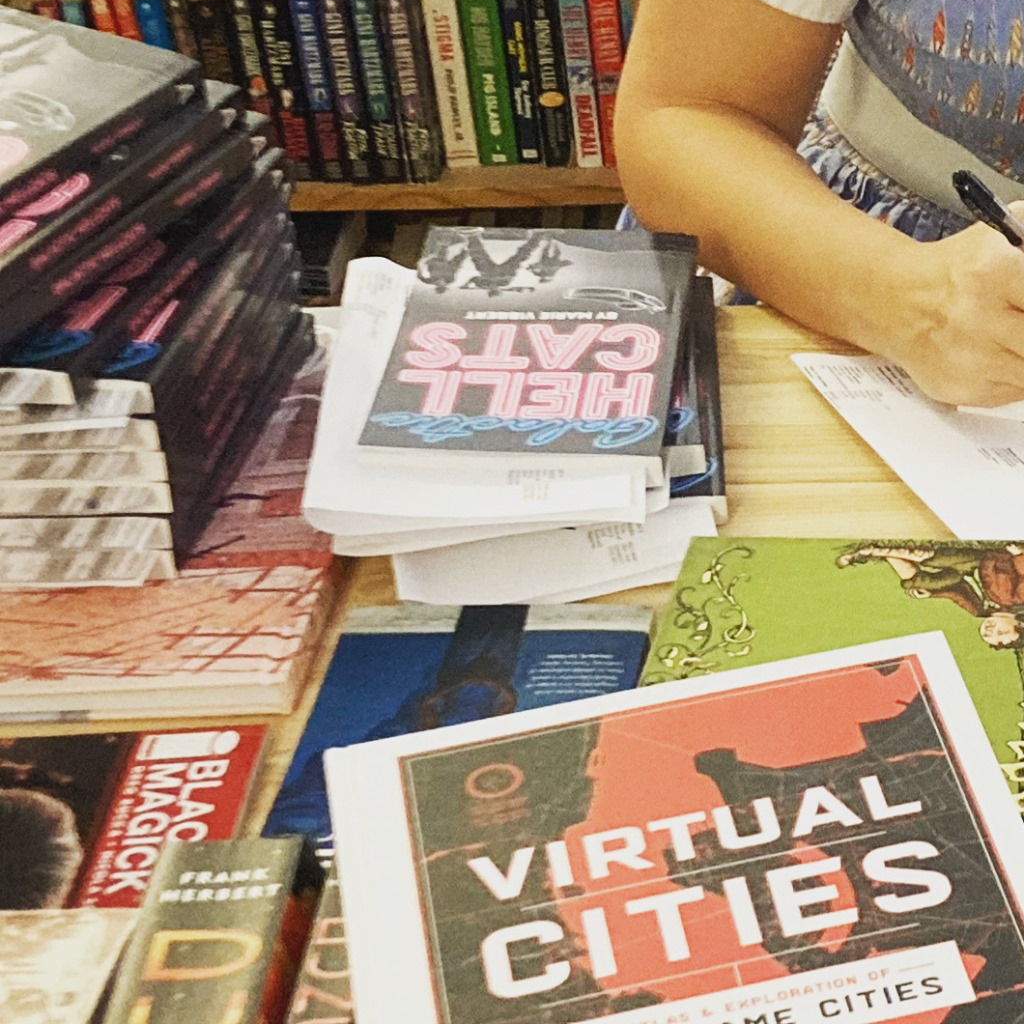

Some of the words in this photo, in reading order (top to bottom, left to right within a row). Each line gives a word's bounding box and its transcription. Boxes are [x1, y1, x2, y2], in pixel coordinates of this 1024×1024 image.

[325, 11, 344, 34] GINI
[355, 13, 373, 35] GINI
[388, 11, 407, 34] GINI
[563, 4, 585, 25] SUE
[593, 0, 615, 23] SUE
[432, 13, 454, 62] STIGMA
[533, 18, 555, 64] DINOSAUR
[567, 26, 590, 61] HENRY
[596, 25, 623, 65] HENRY
[329, 36, 354, 95] HARTZMARK
[360, 37, 385, 97] HARTZMARK
[392, 37, 418, 96] HARTZMARK
[481, 72, 495, 93] PIG
[539, 65, 558, 90] CLUB
[484, 94, 502, 137] ISLAND
[574, 94, 598, 159] DEADFALL
[539, 311, 592, 320] MARIE
[594, 311, 619, 320] BY
[405, 322, 661, 371] CATS
[398, 369, 654, 420] HELL
[369, 411, 660, 449] Galactic
[167, 759, 230, 843] BLAC
[104, 761, 189, 895] MAGICK
[467, 774, 923, 902] VIRTUAL
[159, 883, 283, 903] HERBERT
[179, 867, 270, 885] FRANK
[482, 839, 954, 1000] CITIES
[724, 975, 860, 1012] EXPLORATION
[868, 967, 891, 982] OF
[818, 975, 945, 1019] CITIES
